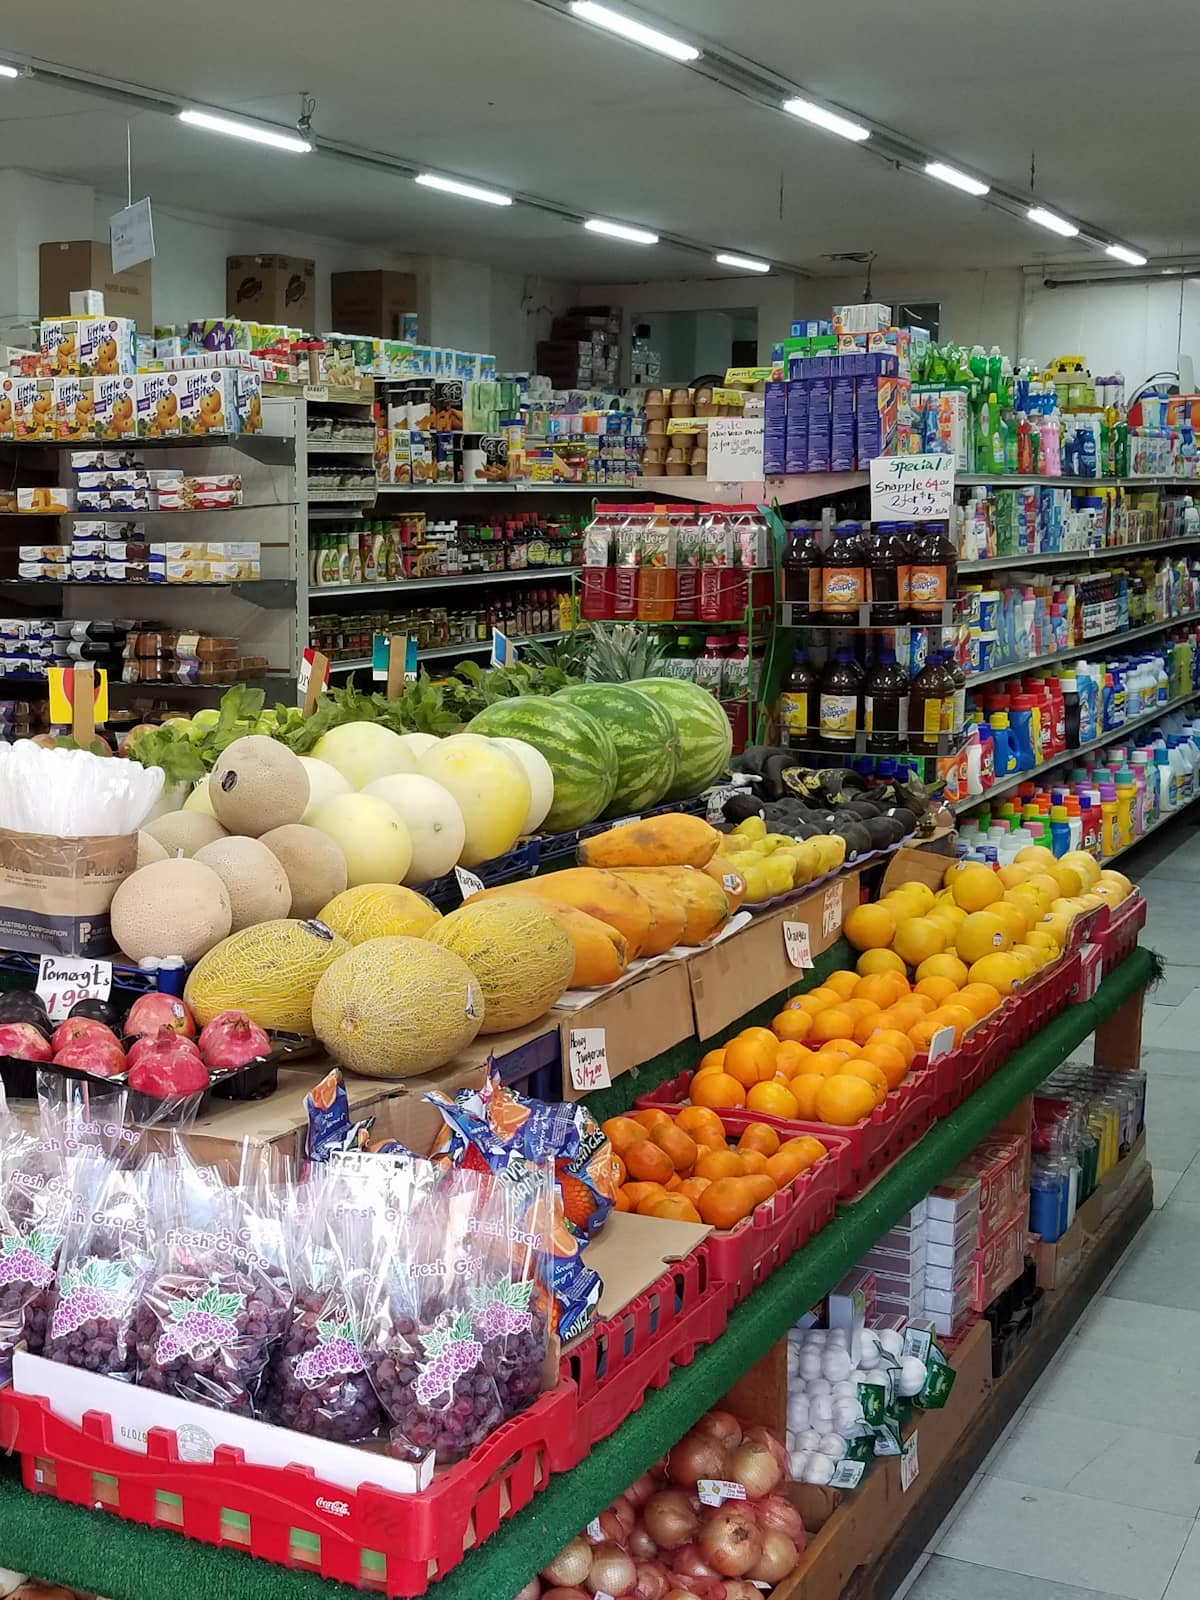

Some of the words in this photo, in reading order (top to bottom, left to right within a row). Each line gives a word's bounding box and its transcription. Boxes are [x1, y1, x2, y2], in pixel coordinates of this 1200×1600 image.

[43, 325, 60, 342] Little
[87, 323, 106, 340] Little
[49, 336, 68, 350] Bites
[92, 334, 113, 348] Bites
[17, 383, 36, 400] Little
[60, 382, 78, 399] Little
[100, 380, 120, 398] Little
[144, 379, 164, 396] Little
[187, 374, 208, 394] Little
[193, 383, 216, 401] Bites
[23, 395, 44, 407] Bites
[65, 394, 86, 408] Bites
[107, 392, 128, 406] Bites
[150, 388, 173, 402] Bites
[888, 457, 942, 479] Special
[873, 478, 922, 493] Snapple
[616, 531, 641, 544] Aloe
[641, 531, 667, 544] Aloe
[827, 579, 860, 594] Snapple
[666, 663, 694, 677] Aloe
[694, 663, 718, 677] Aloe
[724, 663, 749, 677] Aloe
[64, 1120, 101, 1135] Fresh
[103, 1124, 141, 1144] Grap
[9, 1170, 46, 1191] Fresh
[91, 1211, 146, 1233] Grape
[165, 1230, 209, 1249] Fresh
[214, 1241, 270, 1269] Grape
[408, 1262, 448, 1279] Fresh
[315, 1496, 349, 1515] Coca-Cola
